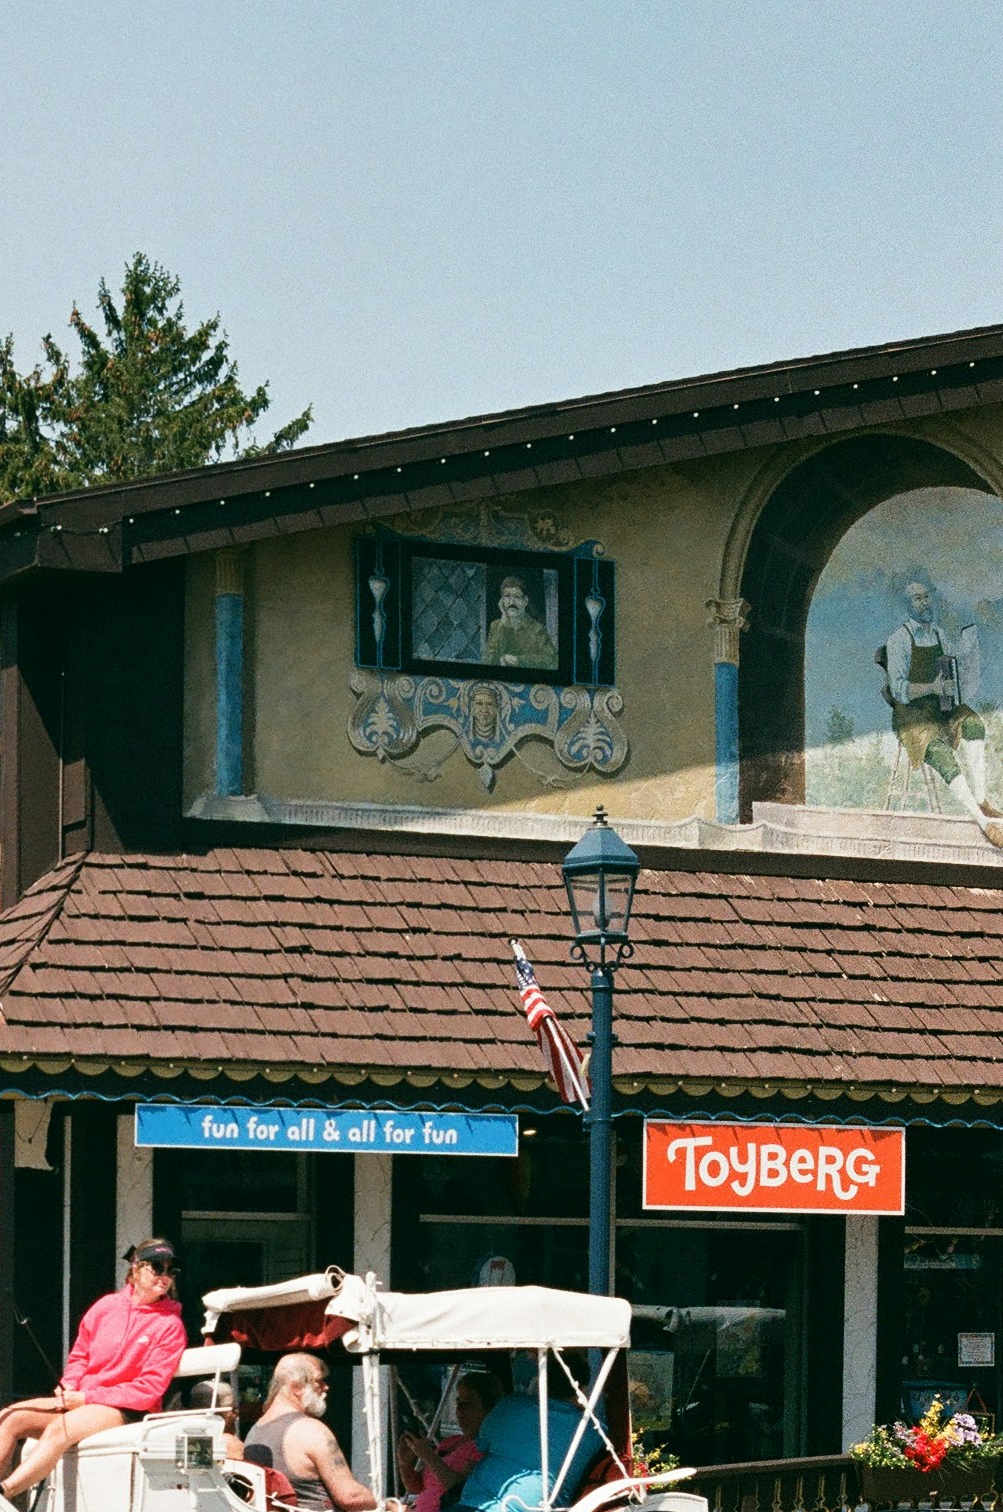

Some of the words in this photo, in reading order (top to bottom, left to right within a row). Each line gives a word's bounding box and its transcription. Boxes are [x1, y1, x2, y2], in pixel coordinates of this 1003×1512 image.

[202, 1115, 239, 1138] fun
[247, 1116, 279, 1140] for
[287, 1118, 315, 1141] all
[322, 1119, 340, 1141] &
[348, 1120, 376, 1142] all
[384, 1120, 415, 1144] for
[422, 1121, 458, 1144] fun
